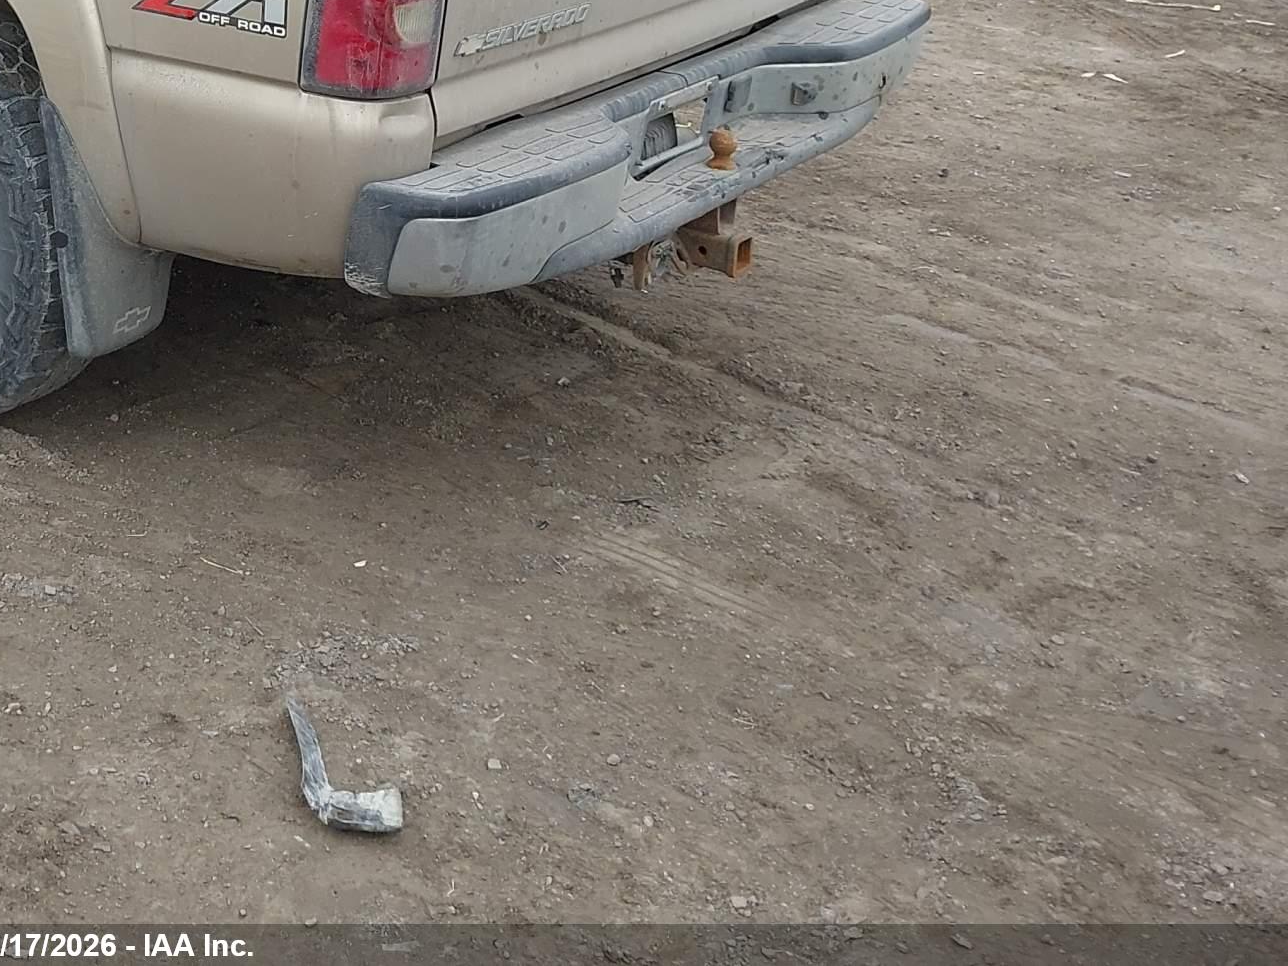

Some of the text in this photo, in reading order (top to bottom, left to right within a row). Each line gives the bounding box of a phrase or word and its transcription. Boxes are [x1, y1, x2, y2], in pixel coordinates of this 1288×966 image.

[198, 10, 287, 38] OFF ROAD
[481, 2, 591, 50] SILVERADO
